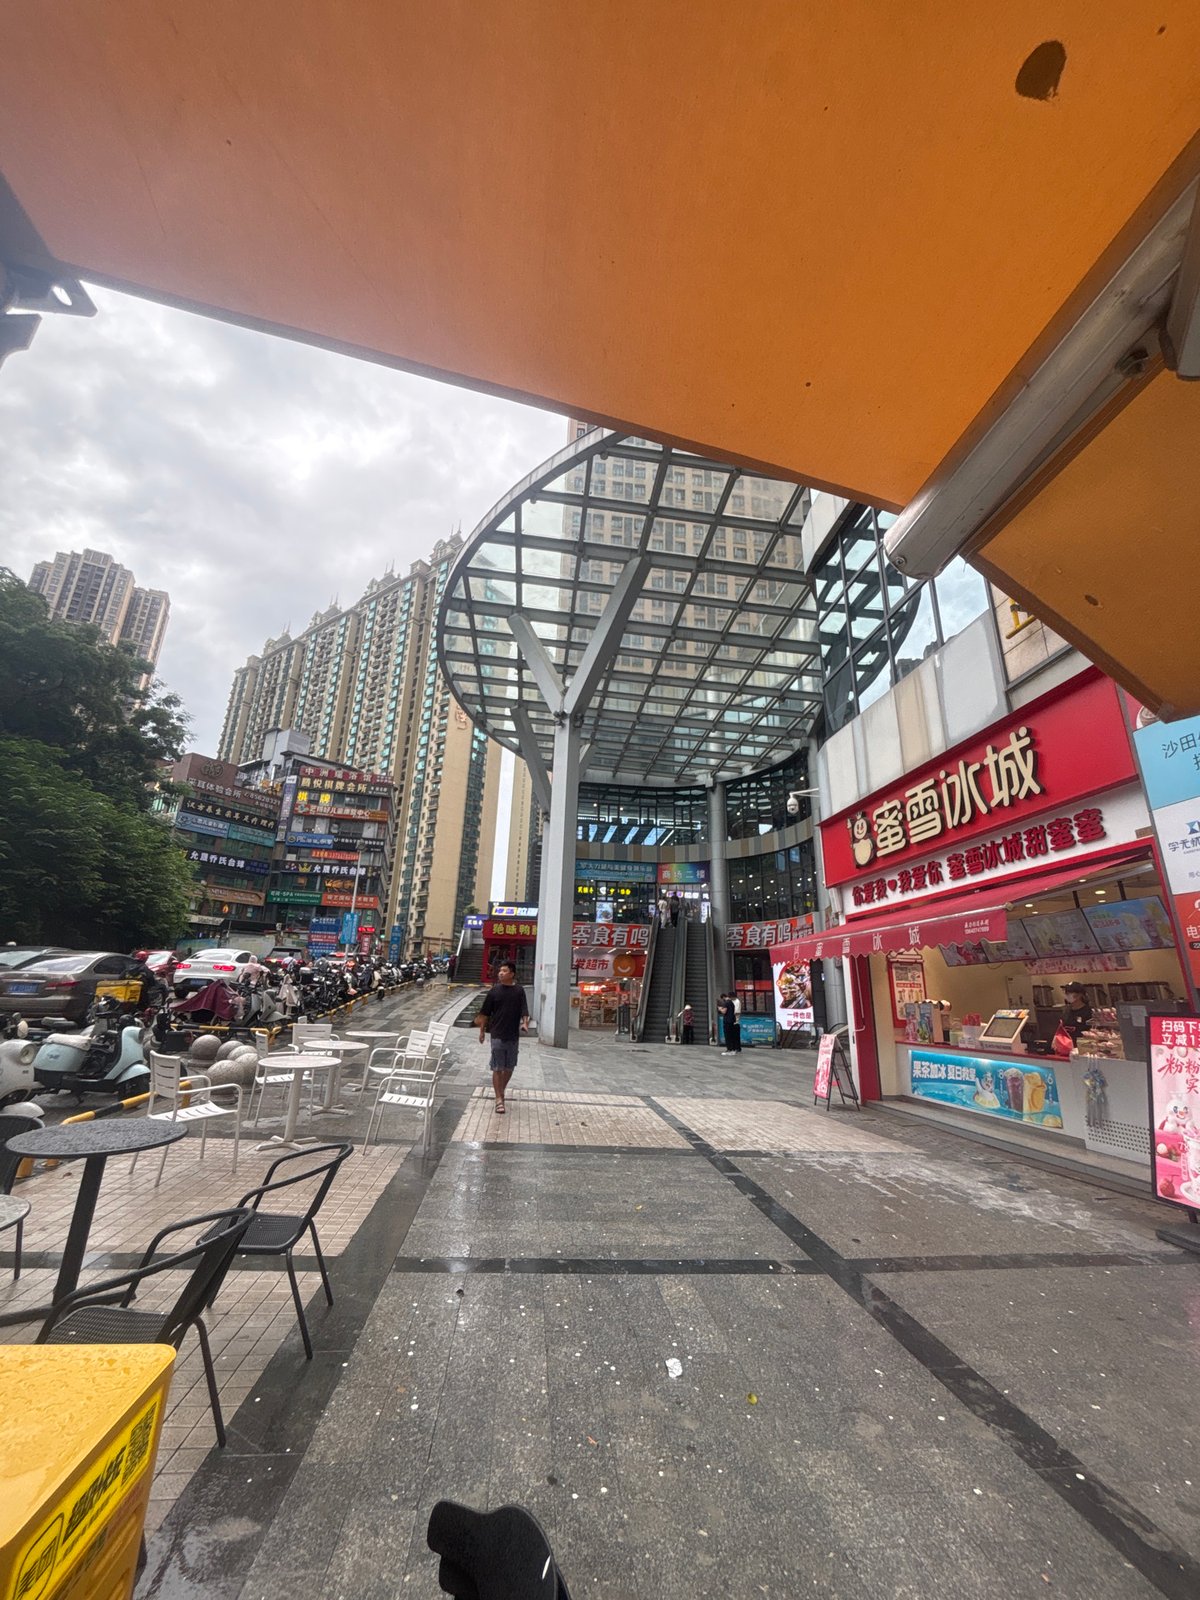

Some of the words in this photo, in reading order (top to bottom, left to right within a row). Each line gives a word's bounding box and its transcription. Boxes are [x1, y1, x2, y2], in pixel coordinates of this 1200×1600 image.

[873, 726, 1041, 857] 蜜雪冰城
[947, 808, 1107, 880] 蜜雪冰城甜蜜蜜
[571, 924, 649, 946] 零食有鸣
[727, 921, 792, 948] 零食有鸣
[1186, 925, 1200, 939] 电
[571, 958, 609, 970] 发超市
[1161, 1020, 1200, 1034] 扫码下
[913, 1060, 946, 1080] 果茶加冰
[947, 1064, 976, 1081] 夏日救星
